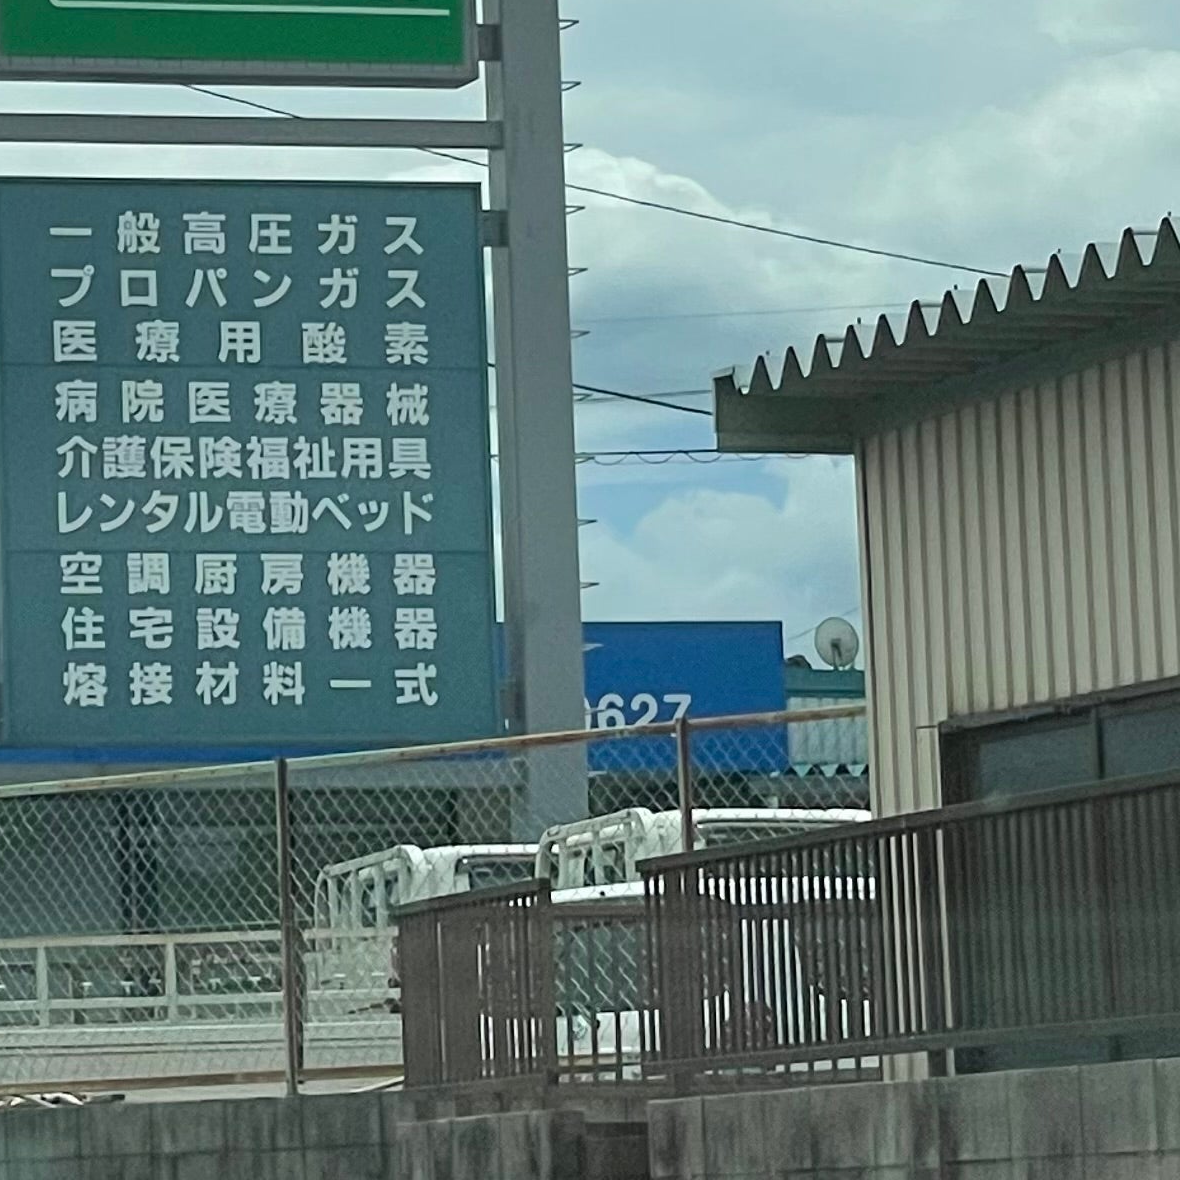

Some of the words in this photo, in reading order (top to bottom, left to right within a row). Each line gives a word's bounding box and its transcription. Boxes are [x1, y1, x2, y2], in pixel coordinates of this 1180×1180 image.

[49, 210, 425, 256] 一般高圧ガス
[50, 264, 427, 309] プロパンガス
[52, 319, 429, 365] 医療用酸素
[54, 379, 430, 426] 病院医療器械
[56, 434, 432, 480] 介護保険福祉用具
[57, 489, 434, 535] レンタル電動ベッド
[59, 551, 437, 597] 空調厨房機器
[61, 606, 438, 650] 住宅設備機器
[62, 661, 439, 708] 熔接材料一式
[583, 692, 692, 731] 627
